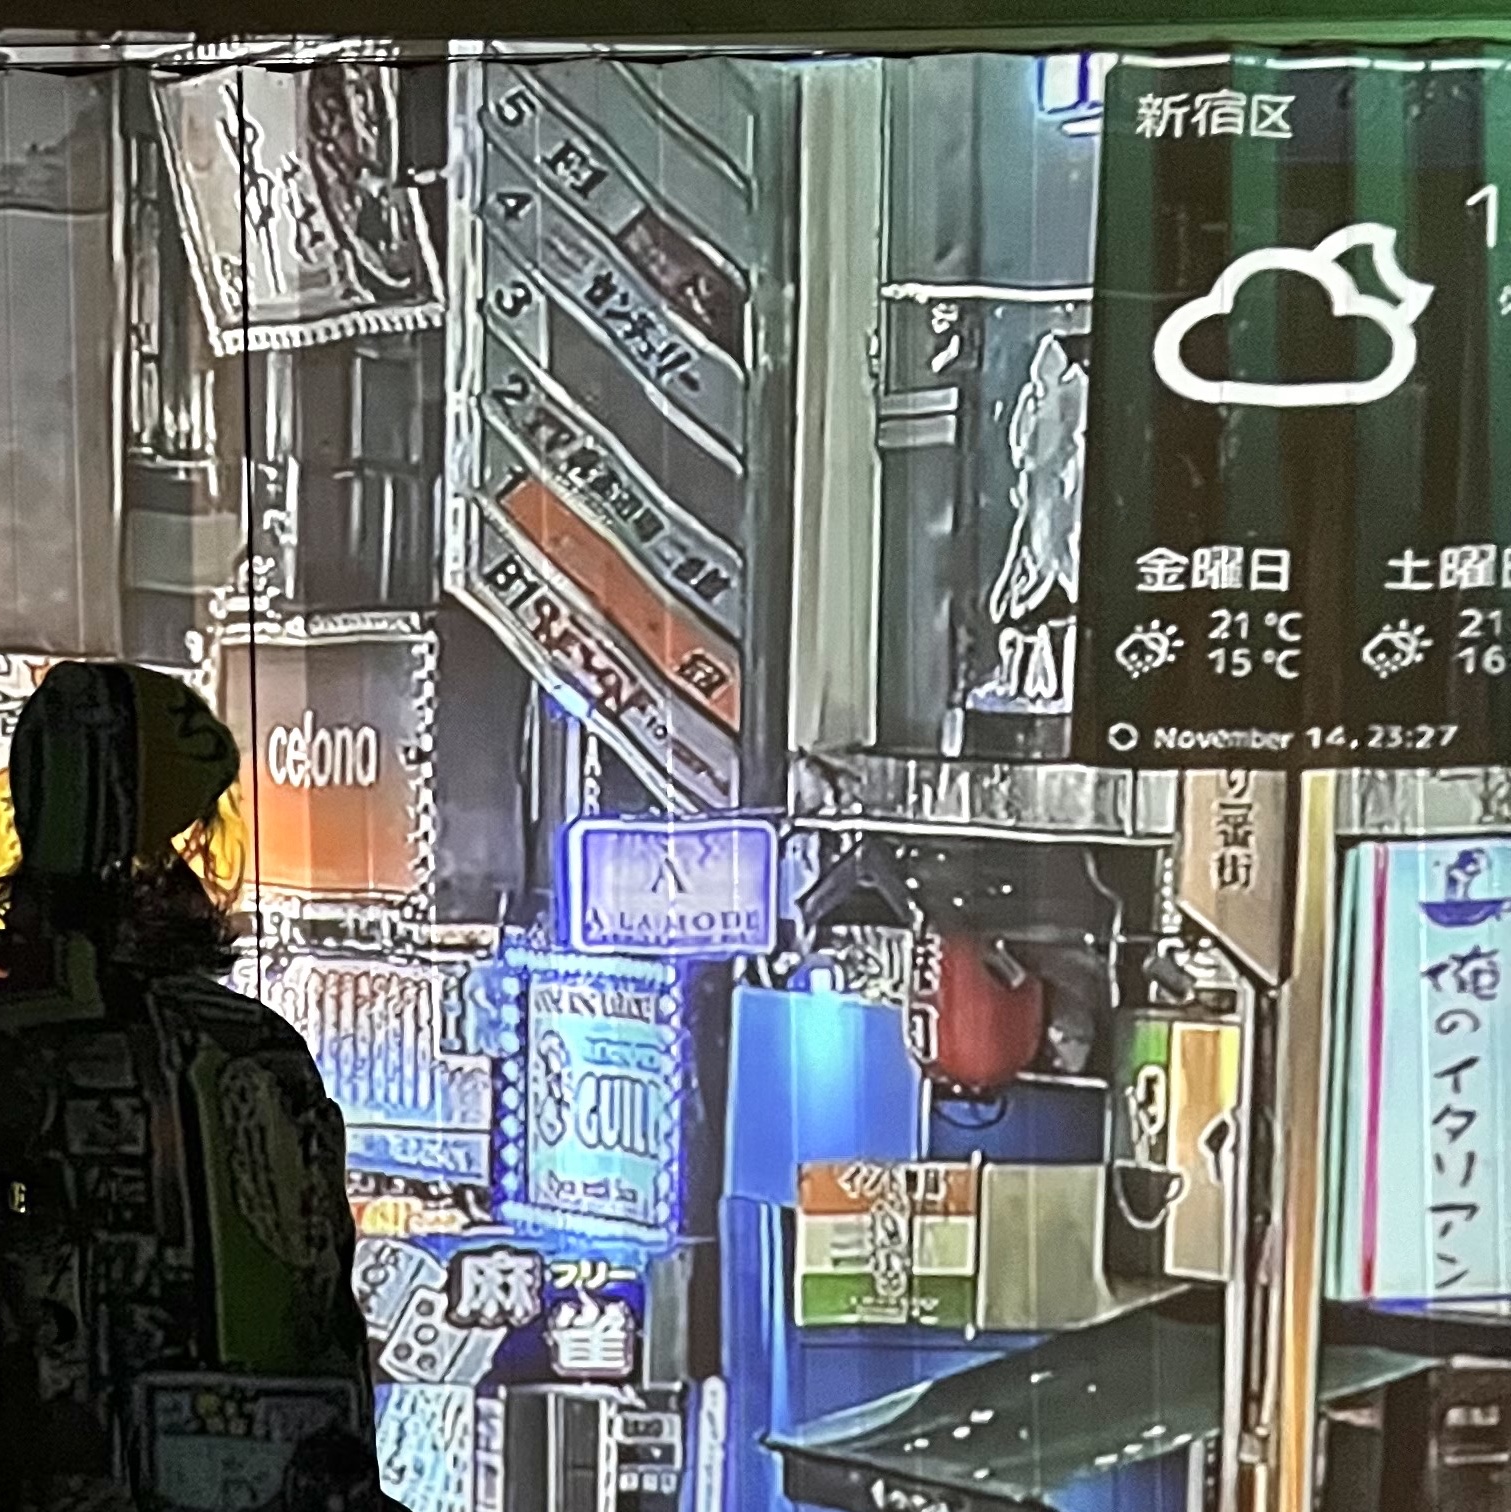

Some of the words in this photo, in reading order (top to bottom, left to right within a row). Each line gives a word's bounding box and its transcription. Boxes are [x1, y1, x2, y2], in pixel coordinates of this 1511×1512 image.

[491, 88, 536, 127] 5
[1136, 89, 1297, 139] 新宿区
[495, 191, 534, 221] 4
[1466, 184, 1498, 248] 1
[494, 280, 533, 318] 3
[491, 372, 531, 403] 2
[1136, 546, 1291, 593] 金曜日
[1384, 544, 1511, 591] 土曜
[1208, 609, 1251, 640] 21
[1458, 608, 1503, 638] 21
[1207, 647, 1253, 678] 15
[1456, 645, 1506, 675] 16
[268, 710, 378, 789] celona
[1153, 727, 1294, 750] November
[1368, 724, 1458, 748] 23:27
[1420, 944, 1502, 1292] 俺のイタリアン
[548, 1261, 637, 1289] フリー
